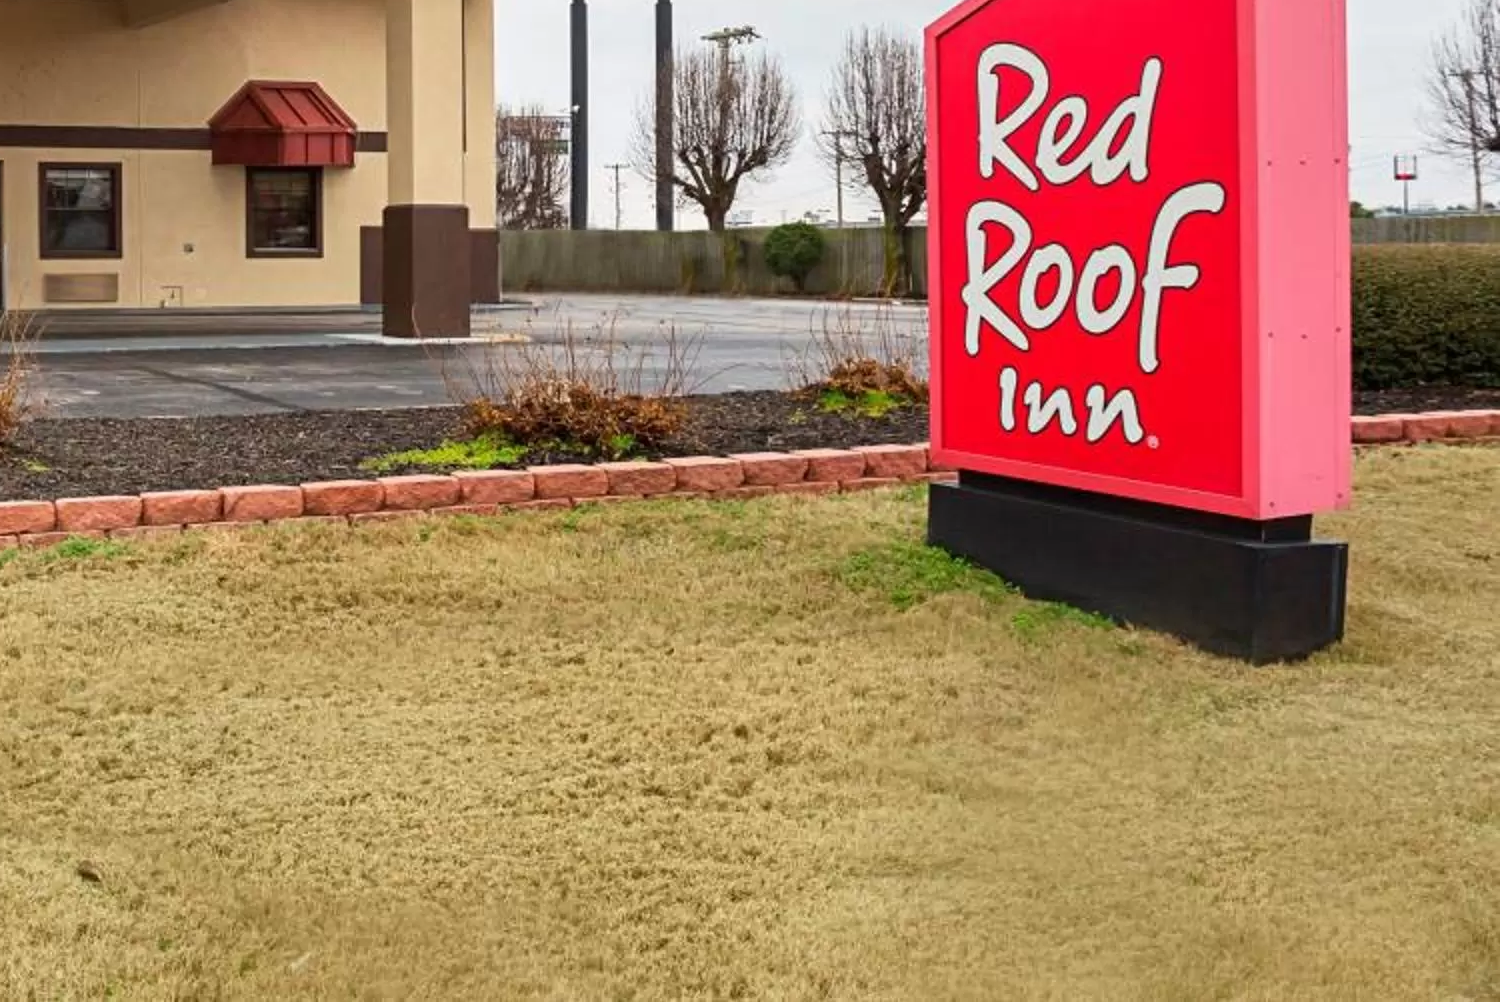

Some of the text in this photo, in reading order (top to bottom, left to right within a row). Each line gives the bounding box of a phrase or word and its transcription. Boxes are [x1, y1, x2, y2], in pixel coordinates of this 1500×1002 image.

[976, 42, 1162, 190] Red
[962, 181, 1225, 373] Roof
[998, 366, 1144, 444] Inn
